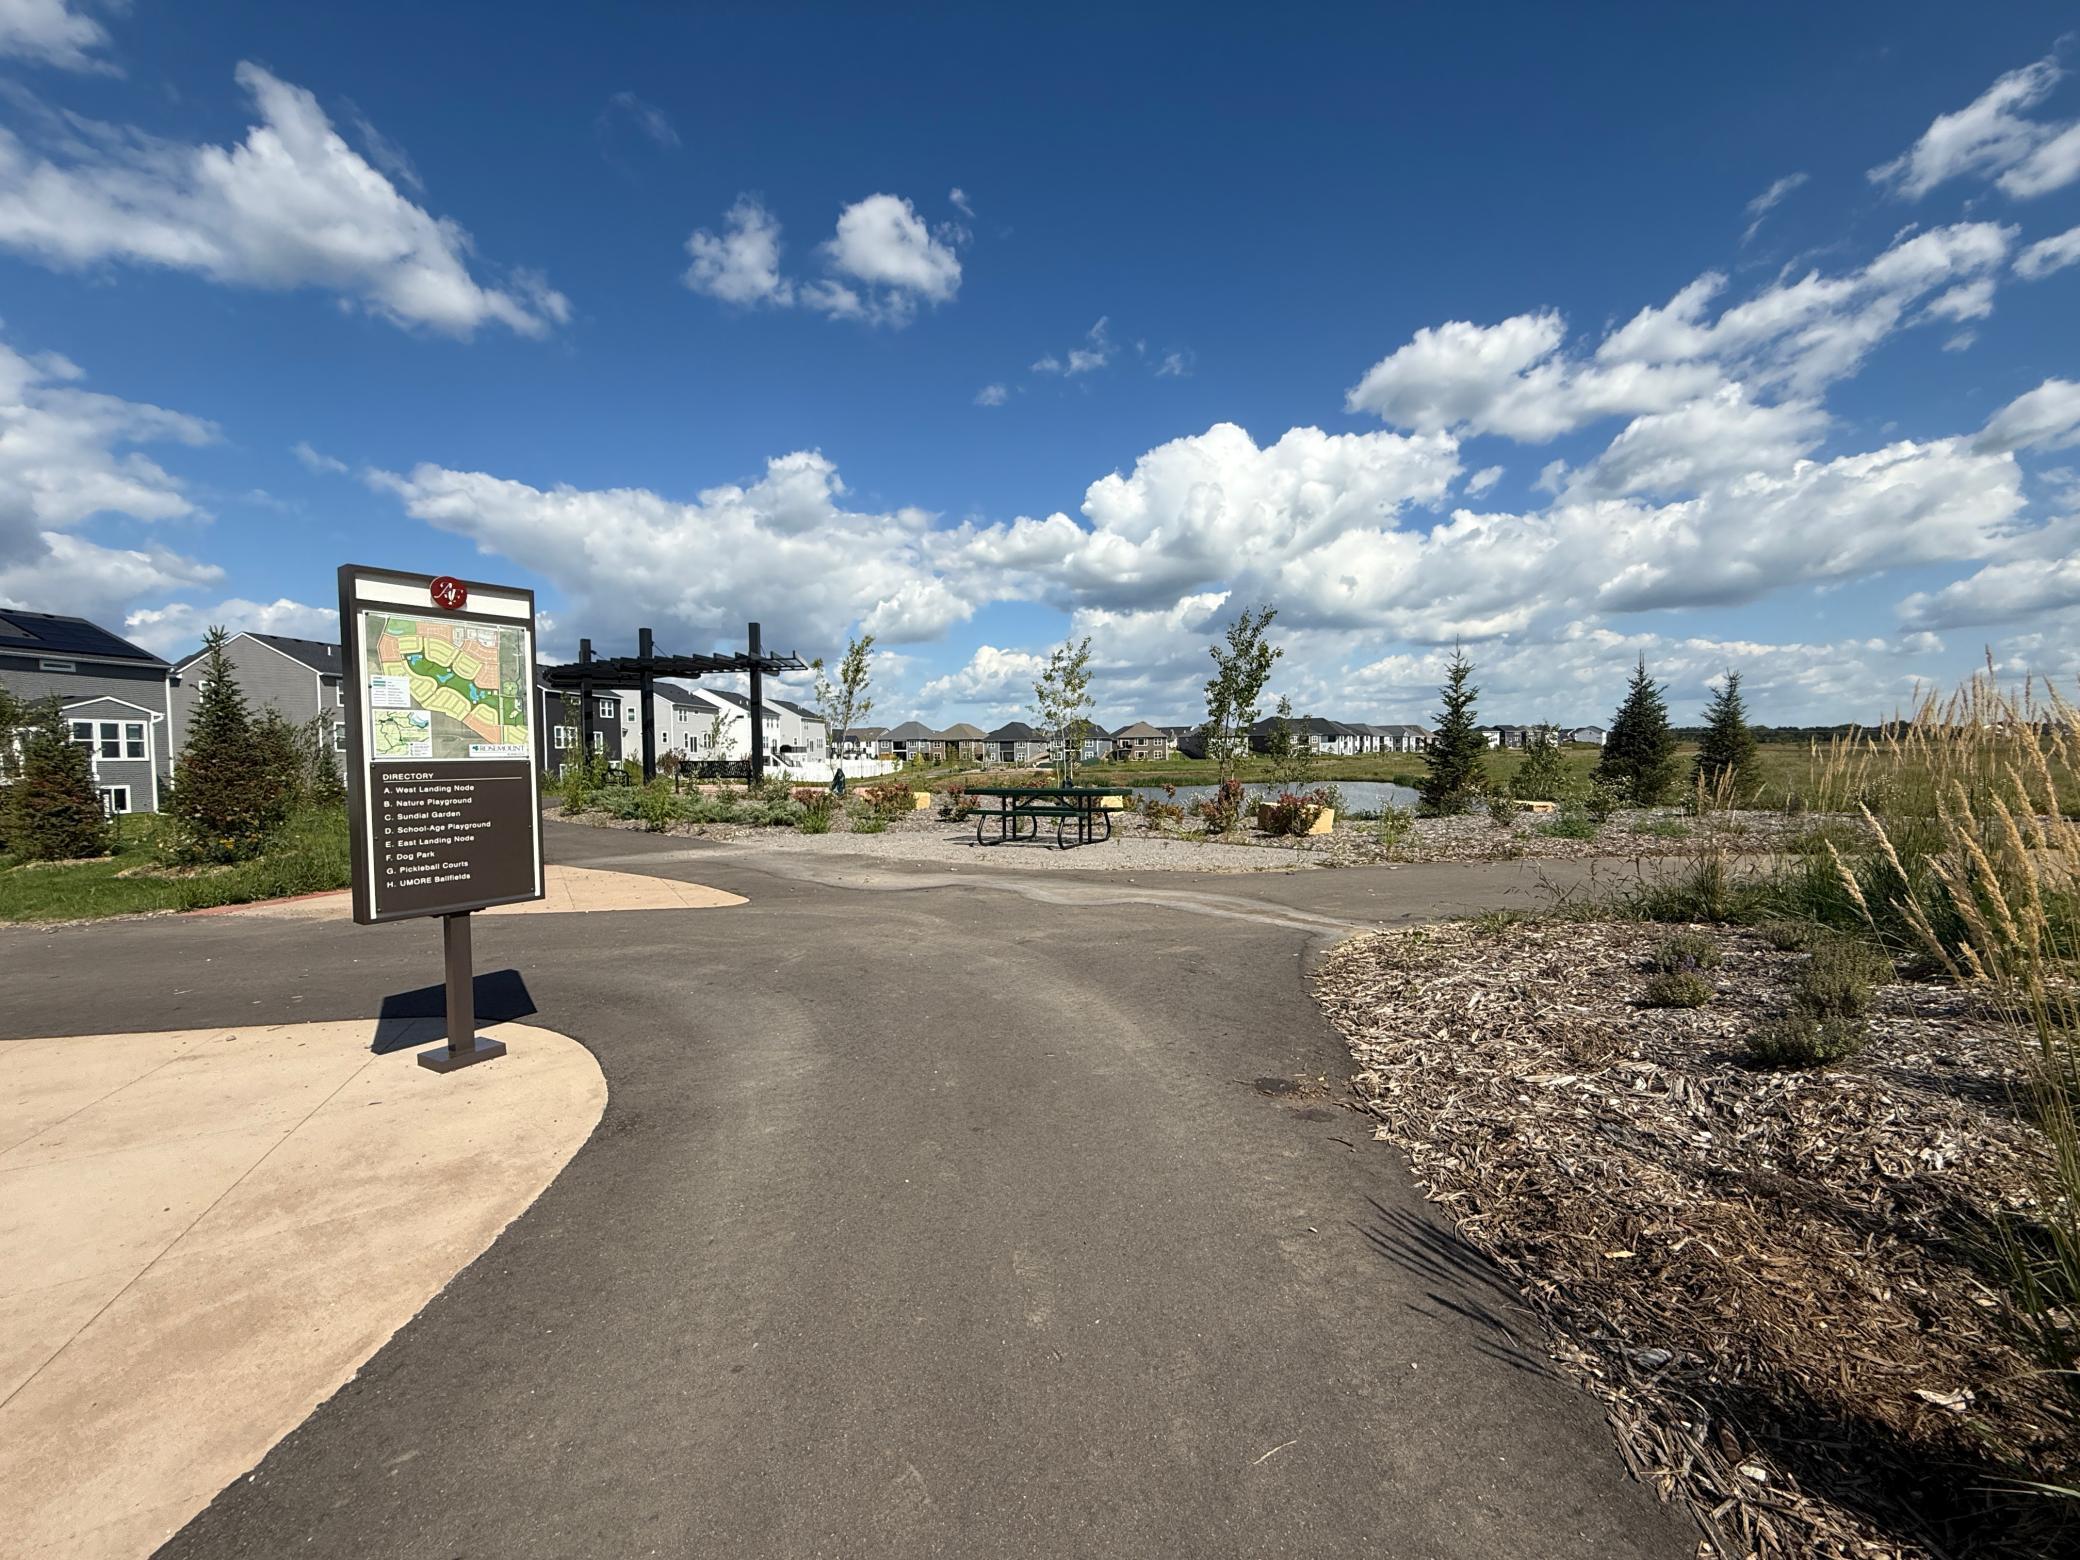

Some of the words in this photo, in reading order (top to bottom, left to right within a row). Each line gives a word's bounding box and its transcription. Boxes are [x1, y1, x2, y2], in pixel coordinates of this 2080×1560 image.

[397, 812, 428, 820] Sundial
[398, 825, 445, 834] School-Age
[448, 821, 491, 830] Playground
[397, 853, 414, 861] Dog
[417, 851, 435, 859] Park
[400, 864, 440, 873] Pickleball
[442, 861, 468, 869] Courts
[400, 877, 432, 887] UMORE
[435, 873, 470, 883] Ballfields
